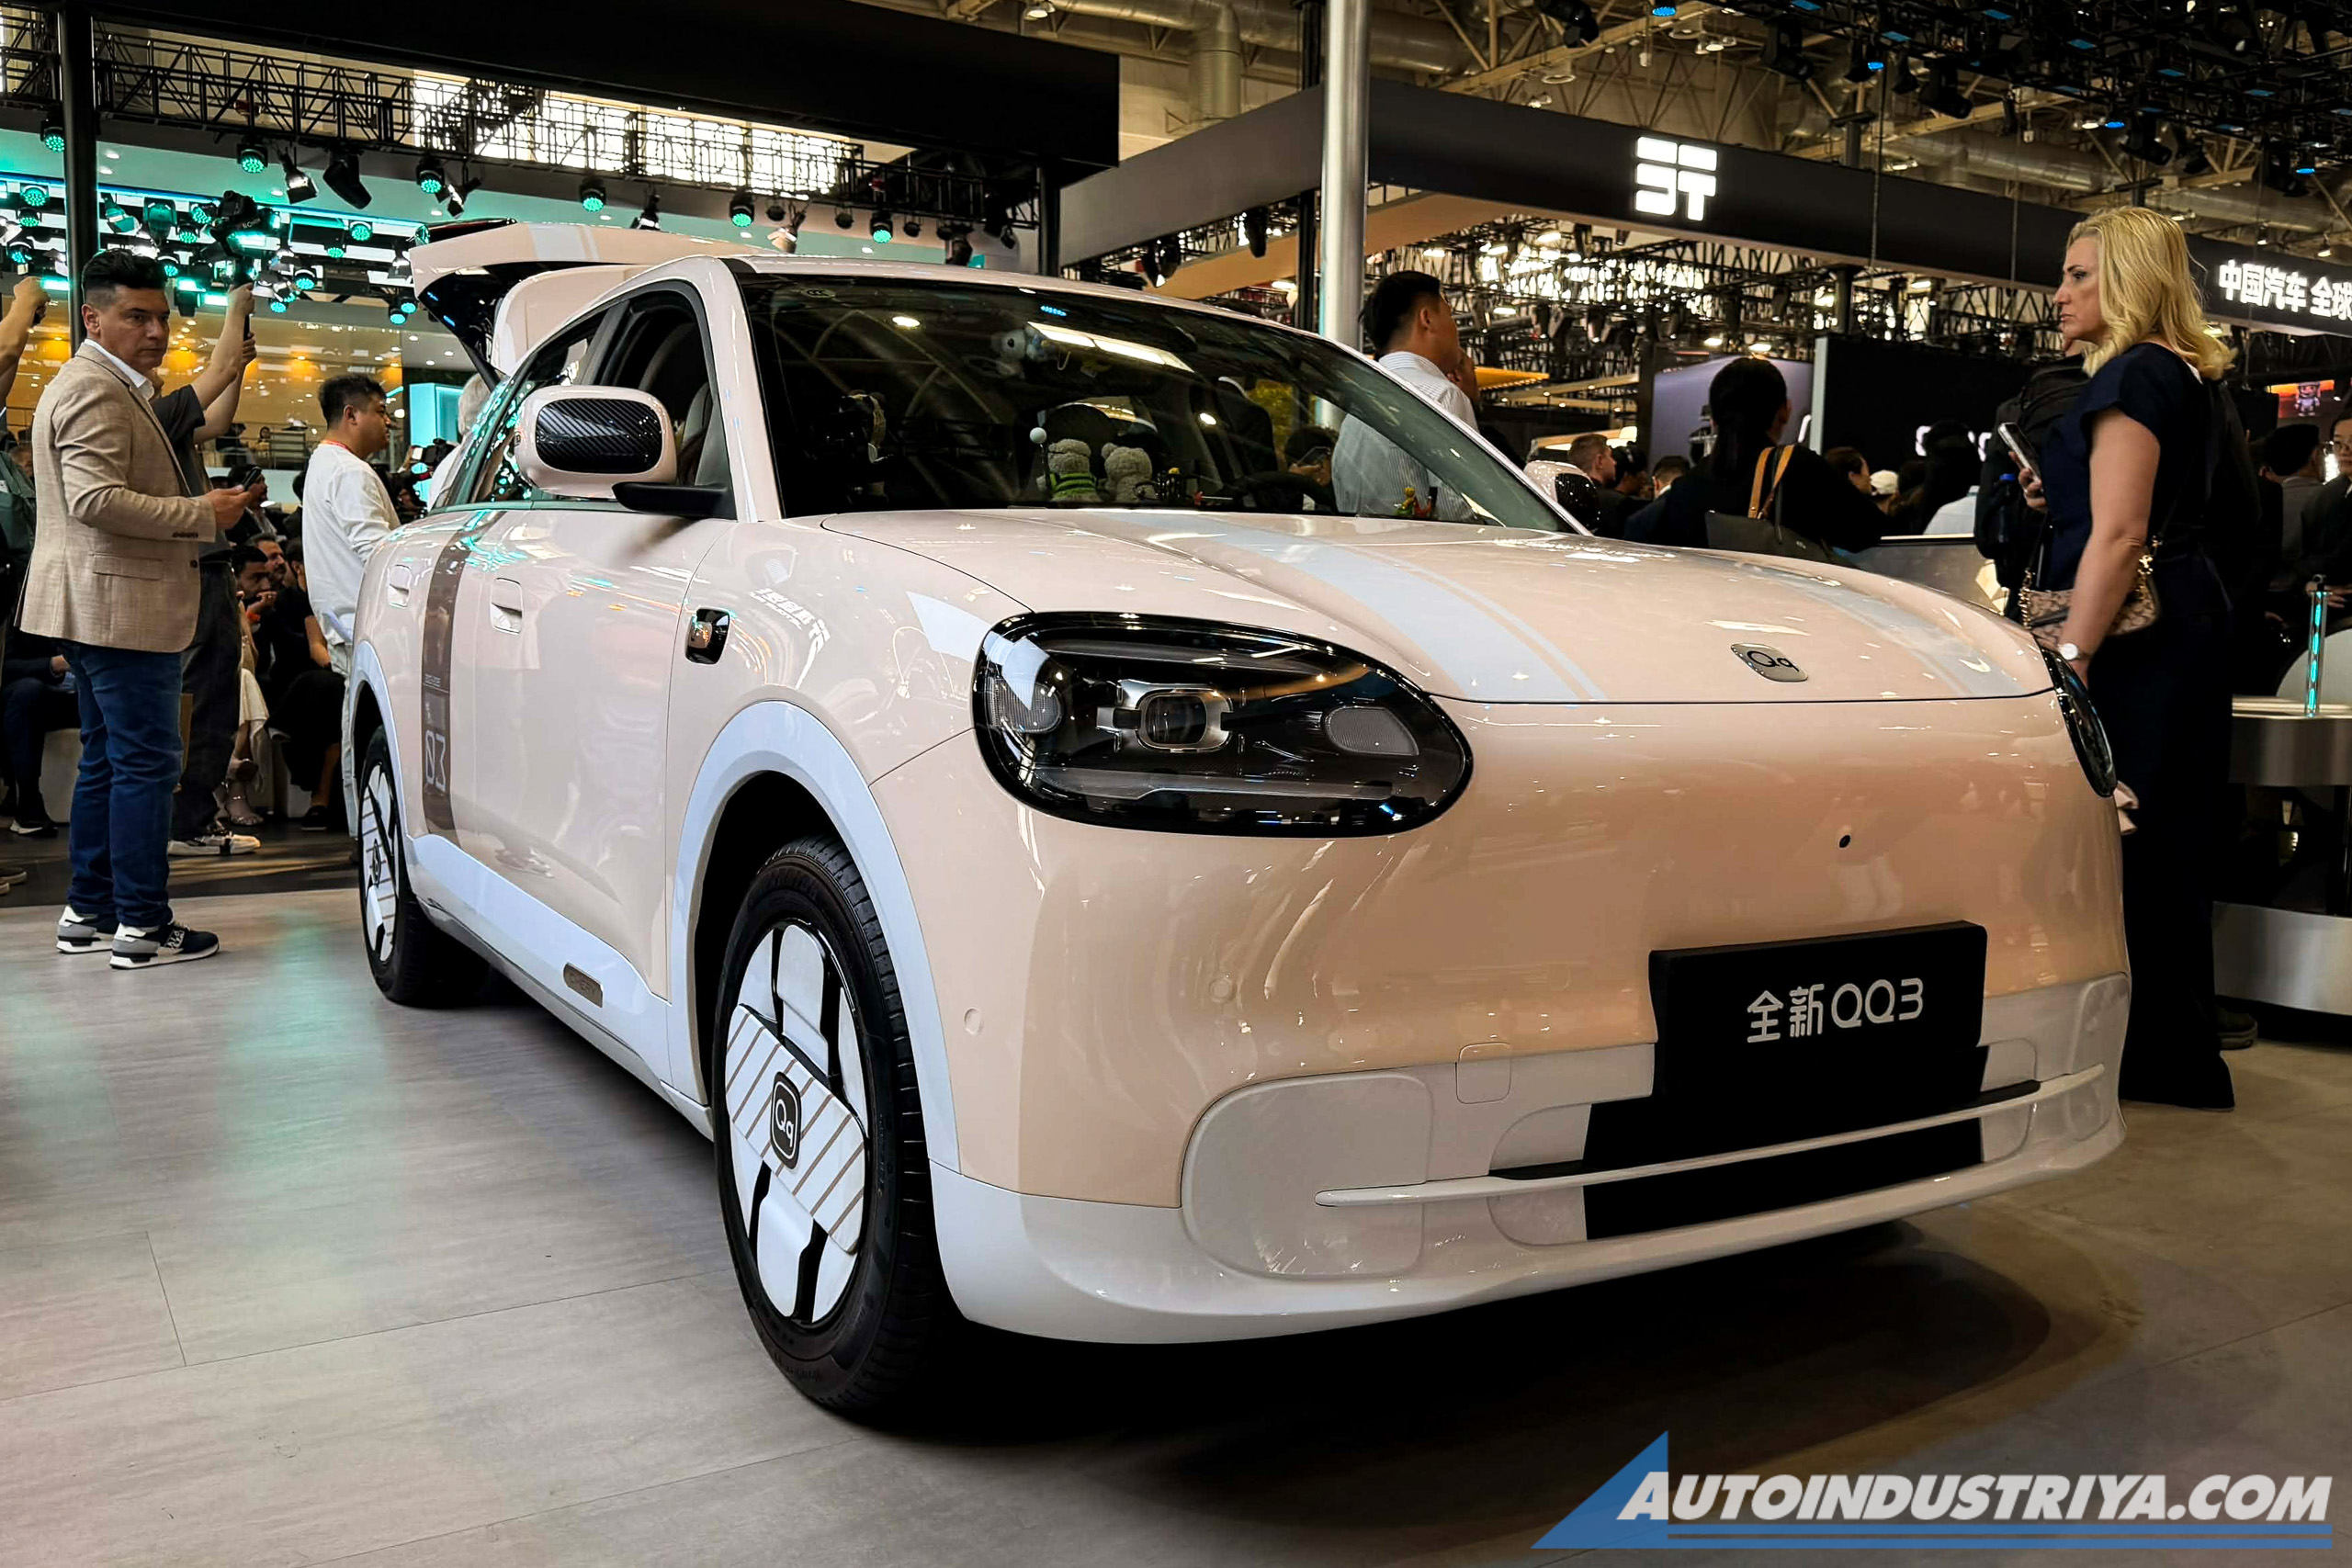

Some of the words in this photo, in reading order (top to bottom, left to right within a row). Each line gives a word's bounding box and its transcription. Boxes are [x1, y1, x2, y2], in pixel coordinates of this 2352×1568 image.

[2218, 259, 2308, 313] 中国汽车
[2309, 276, 2352, 321] 全球
